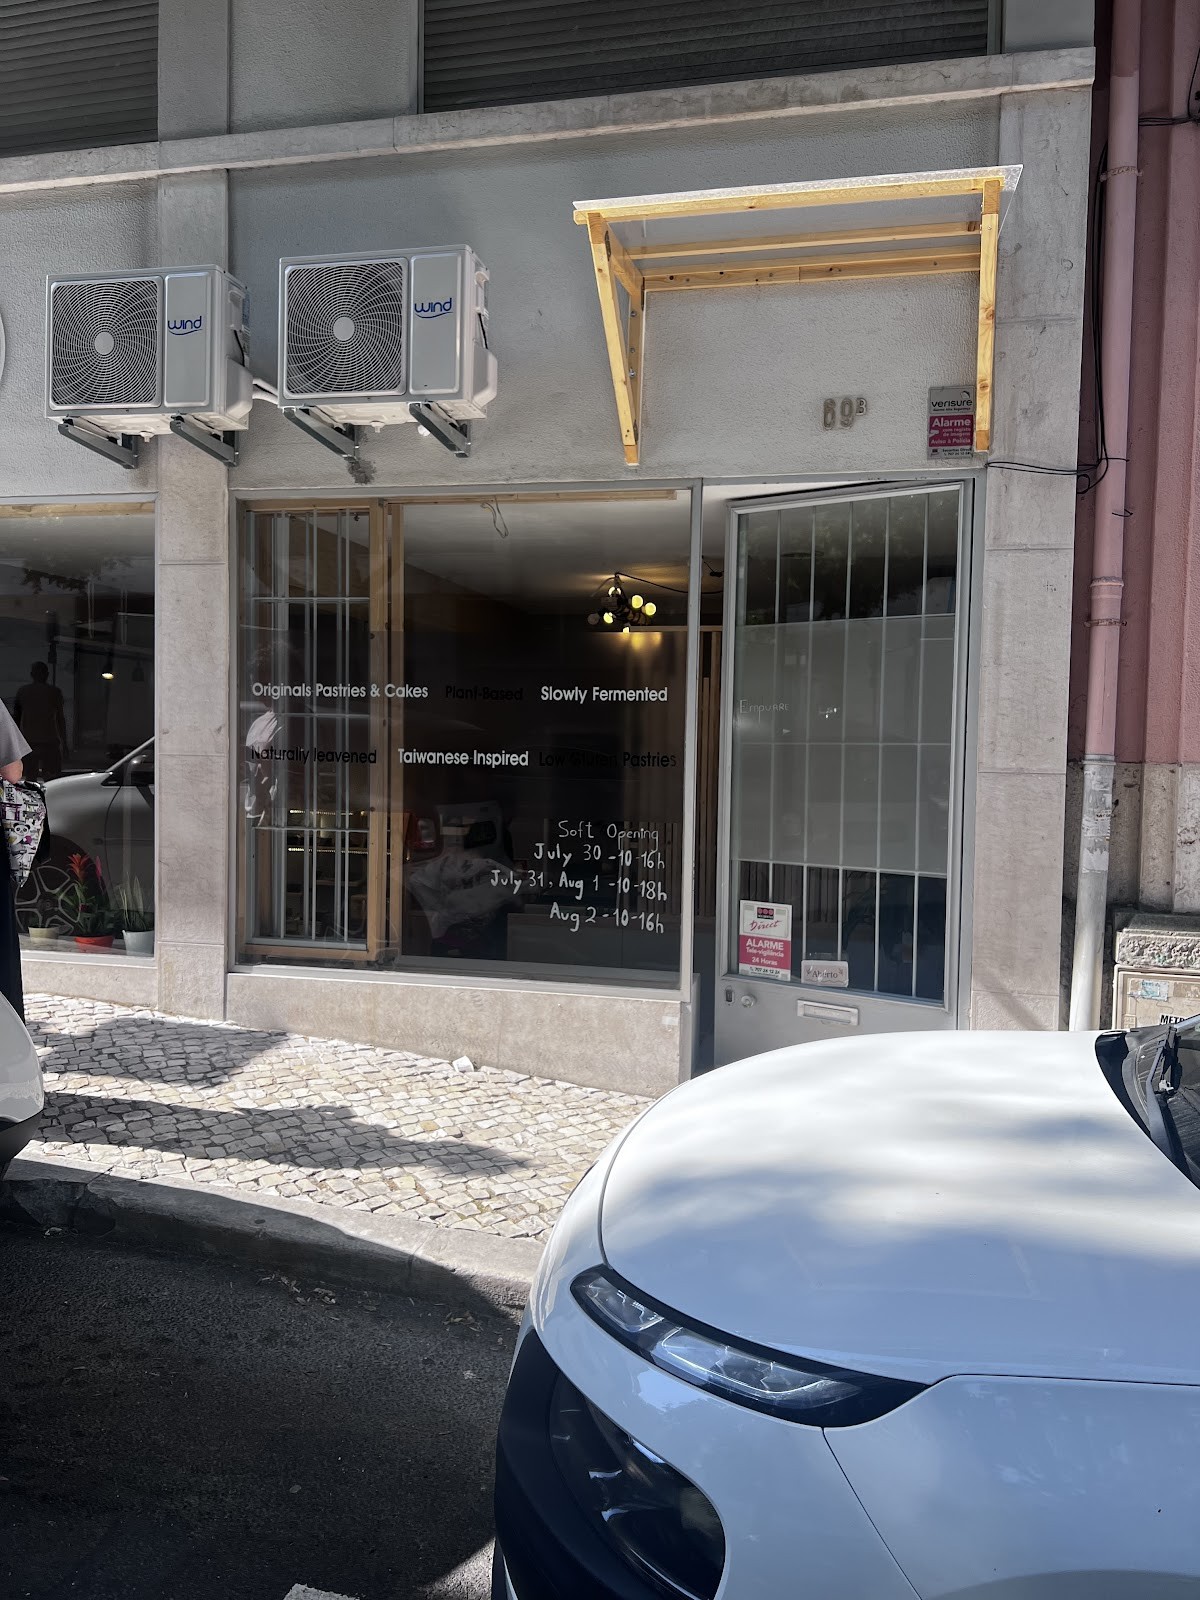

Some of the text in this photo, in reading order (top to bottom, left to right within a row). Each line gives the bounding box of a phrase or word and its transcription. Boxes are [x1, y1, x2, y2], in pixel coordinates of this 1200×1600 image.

[414, 297, 452, 315] wind
[168, 315, 202, 331] wind
[931, 399, 973, 408] verisure
[932, 417, 971, 427] Alarme
[252, 682, 429, 700] Originals Pastries & Cakes
[445, 686, 523, 701] Plant-Based
[540, 685, 668, 704] Slowly Fermented
[251, 746, 377, 764] Naturally leavened
[539, 752, 565, 767] Low
[623, 752, 677, 767] Pastries
[558, 819, 659, 854] Soft Opening
[533, 842, 573, 868] July
[582, 844, 602, 861] 30
[490, 869, 523, 895] July
[558, 871, 584, 901] Aug
[592, 874, 599, 891] 1
[549, 901, 580, 933] Aug
[746, 938, 784, 951] ALARME
[760, 957, 778, 966] Horas
